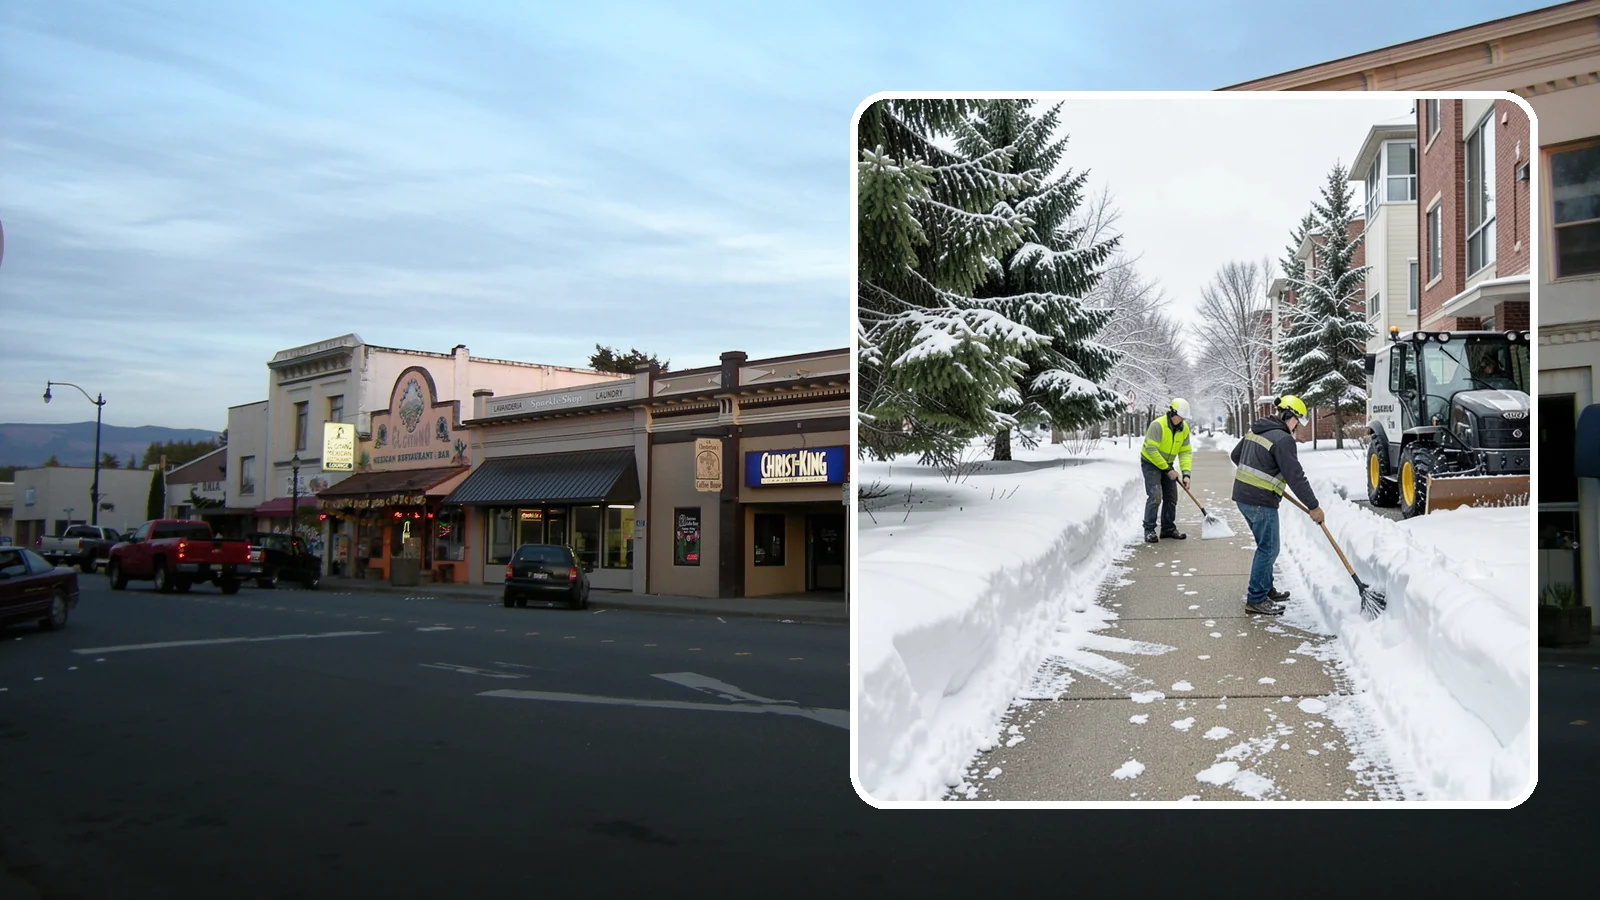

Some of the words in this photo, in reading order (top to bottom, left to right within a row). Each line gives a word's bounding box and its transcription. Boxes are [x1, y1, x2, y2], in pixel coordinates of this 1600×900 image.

[595, 389, 624, 400] LAUNDRY
[493, 402, 523, 413] LAVANDERIA
[530, 397, 561, 409] Sparkle
[562, 394, 583, 404] Shop
[373, 455, 396, 465] MEXICAN
[397, 451, 434, 462] RESTAURANT
[437, 449, 450, 459] BAR
[761, 451, 797, 478] CHRIST
[799, 449, 827, 477] KING
[696, 480, 709, 488] Coffee
[709, 481, 722, 489] House
